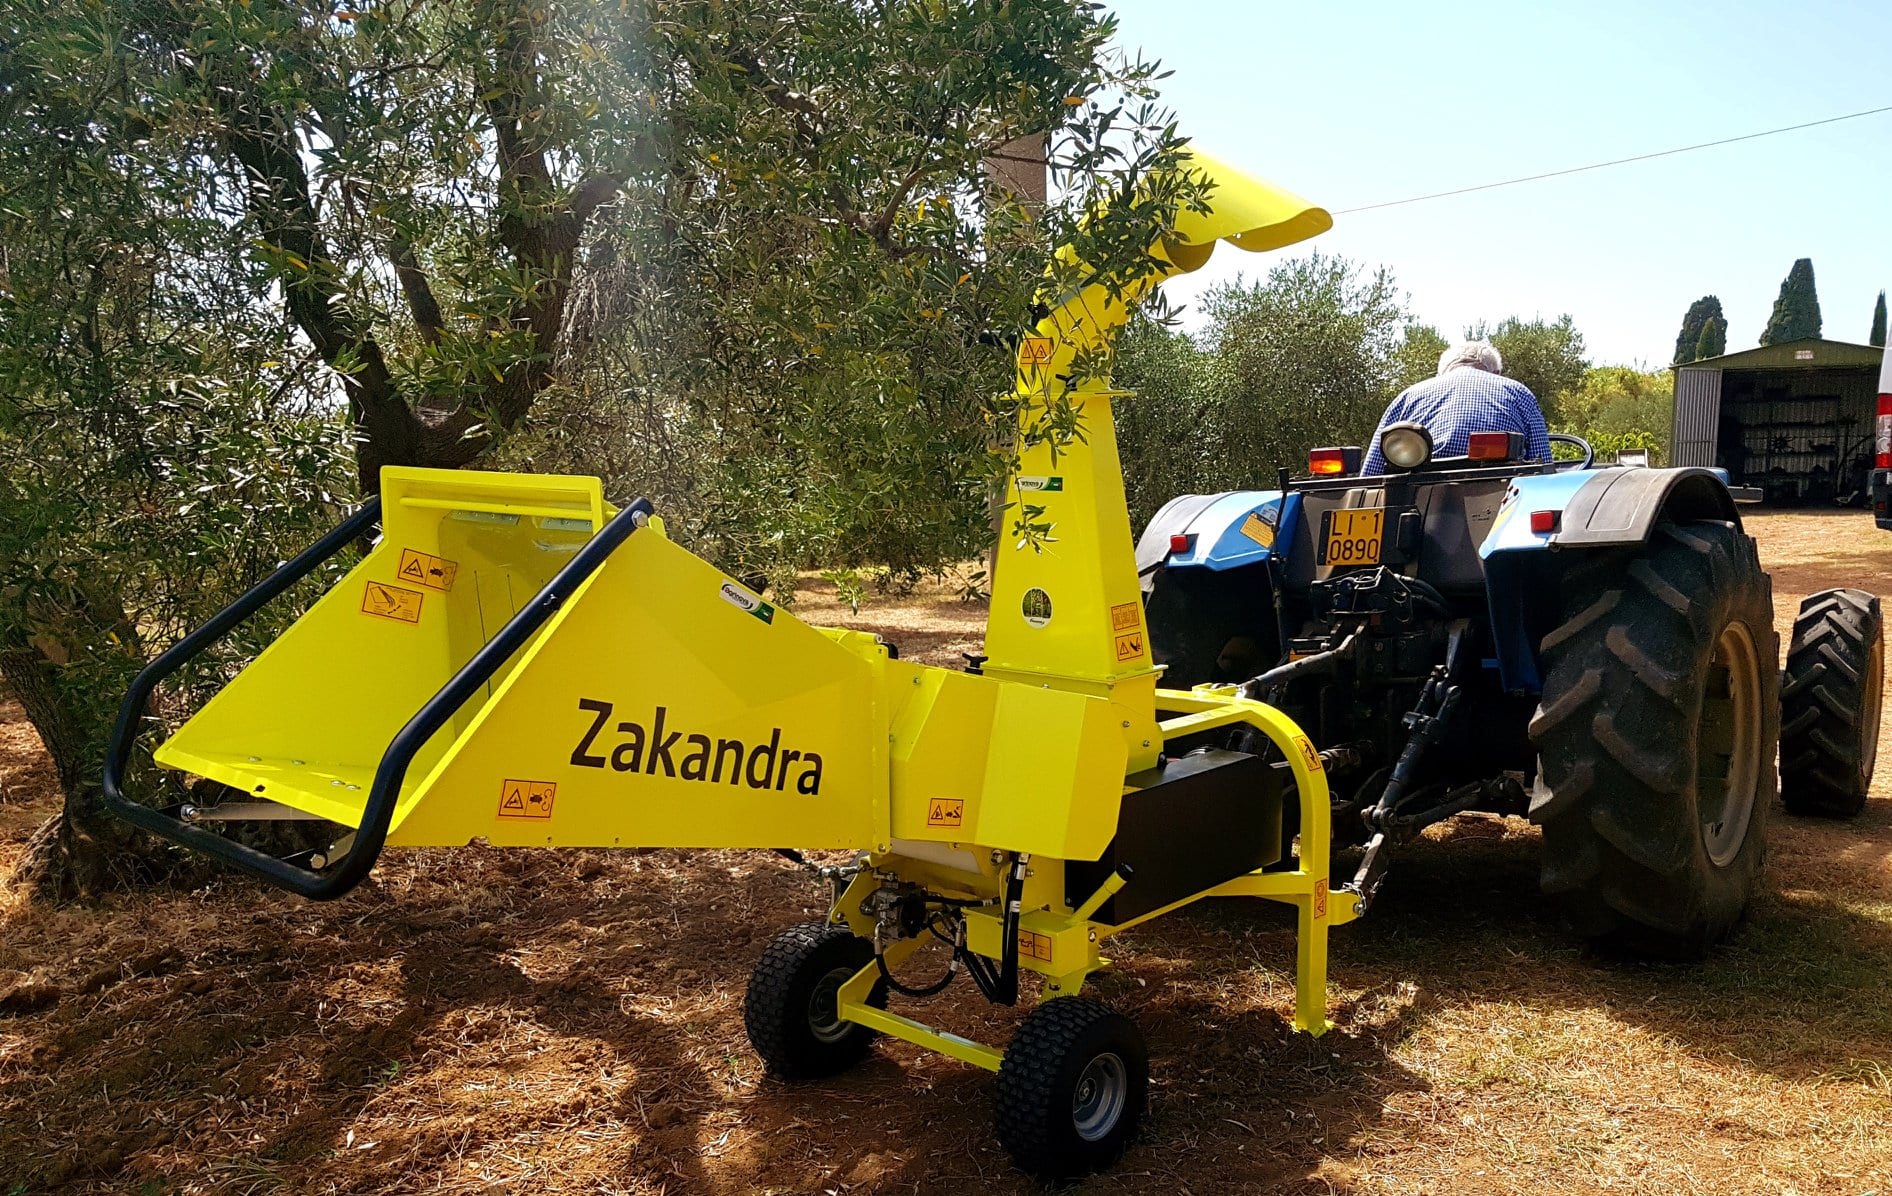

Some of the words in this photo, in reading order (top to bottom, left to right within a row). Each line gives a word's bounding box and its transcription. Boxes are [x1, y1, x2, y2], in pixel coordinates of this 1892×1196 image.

[1332, 511, 1353, 536] LI
[1373, 512, 1380, 534] 1
[1330, 538, 1379, 561] 0890
[570, 697, 823, 796] Zakandra
